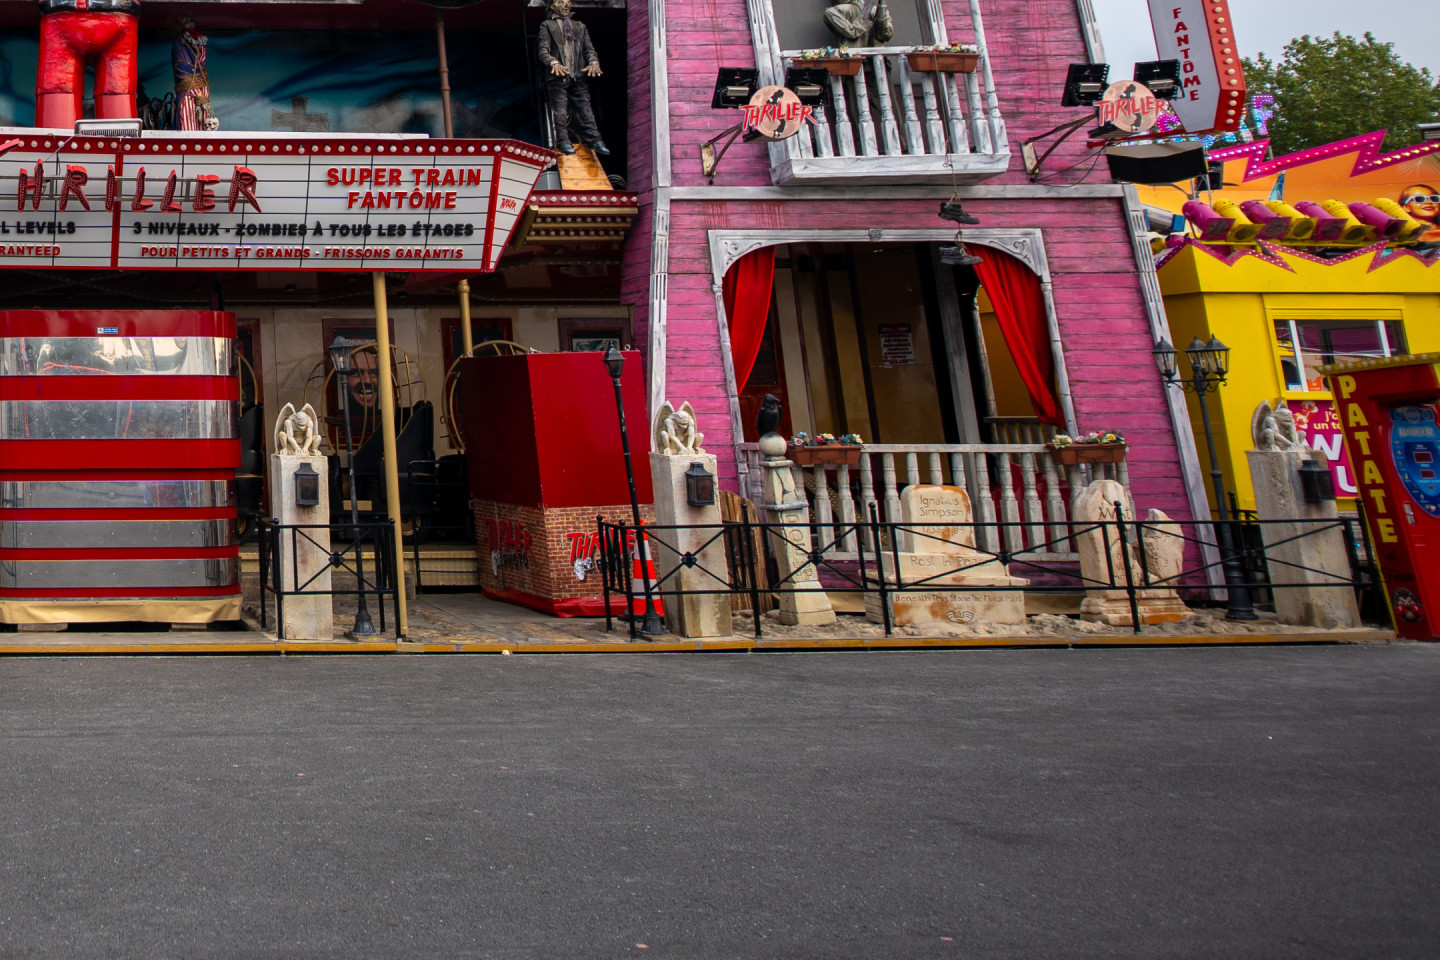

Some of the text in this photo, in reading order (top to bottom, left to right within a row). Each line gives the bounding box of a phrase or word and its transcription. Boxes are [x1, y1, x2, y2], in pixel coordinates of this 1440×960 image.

[1172, 7, 1201, 101] FANTÔME
[740, 101, 819, 130] THRILLER
[1094, 96, 1178, 126] THRILLER
[326, 168, 481, 186] SUPER TRAIN
[347, 188, 457, 209] FANTÔME
[500, 197, 517, 213] THRILLER
[16, 221, 76, 234] LEVELS
[133, 222, 142, 235] 3
[148, 222, 220, 236] NIVEAUX
[235, 223, 307, 237] ZOMBIES
[312, 220, 324, 237] À
[329, 224, 372, 237] TOUS
[377, 223, 407, 237] LES
[411, 220, 474, 237] ÉTAGES
[141, 247, 177, 258] POUR
[182, 247, 230, 258] PETITS
[234, 247, 252, 258] ET
[256, 247, 310, 259] GRANDS
[324, 247, 391, 259] FRISSONS
[395, 247, 464, 259] GARANTIS
[1339, 375, 1398, 544] PATATE
[919, 495, 960, 507] Ignatius
[919, 507, 963, 518] Simpson
[485, 518, 536, 562] THRILLER
[910, 555, 936, 567] Rest
[943, 556, 951, 567] In
[895, 593, 930, 602] Beneath
[932, 594, 949, 602] This
[950, 594, 971, 602] Stone
[971, 594, 983, 602] The
